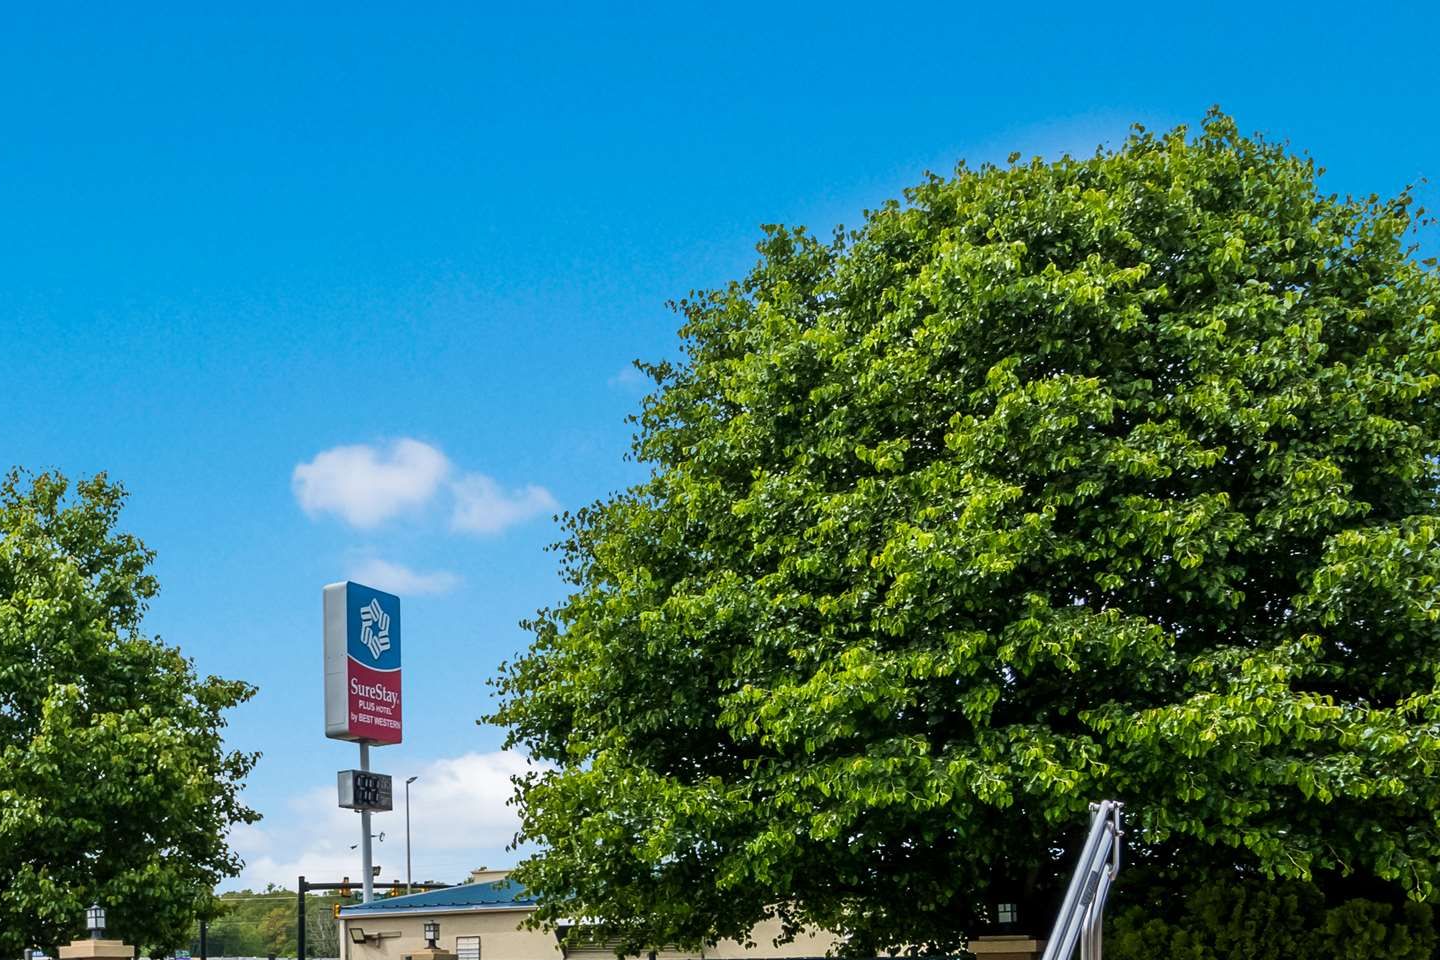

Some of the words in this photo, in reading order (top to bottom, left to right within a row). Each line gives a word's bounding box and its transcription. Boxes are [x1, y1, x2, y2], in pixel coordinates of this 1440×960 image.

[351, 677, 398, 709] SureStay
[359, 700, 375, 711] PLUS
[376, 705, 392, 715] HOTEL
[351, 711, 358, 723] by
[359, 712, 374, 725] BEST
[374, 717, 401, 729] WESTERN
